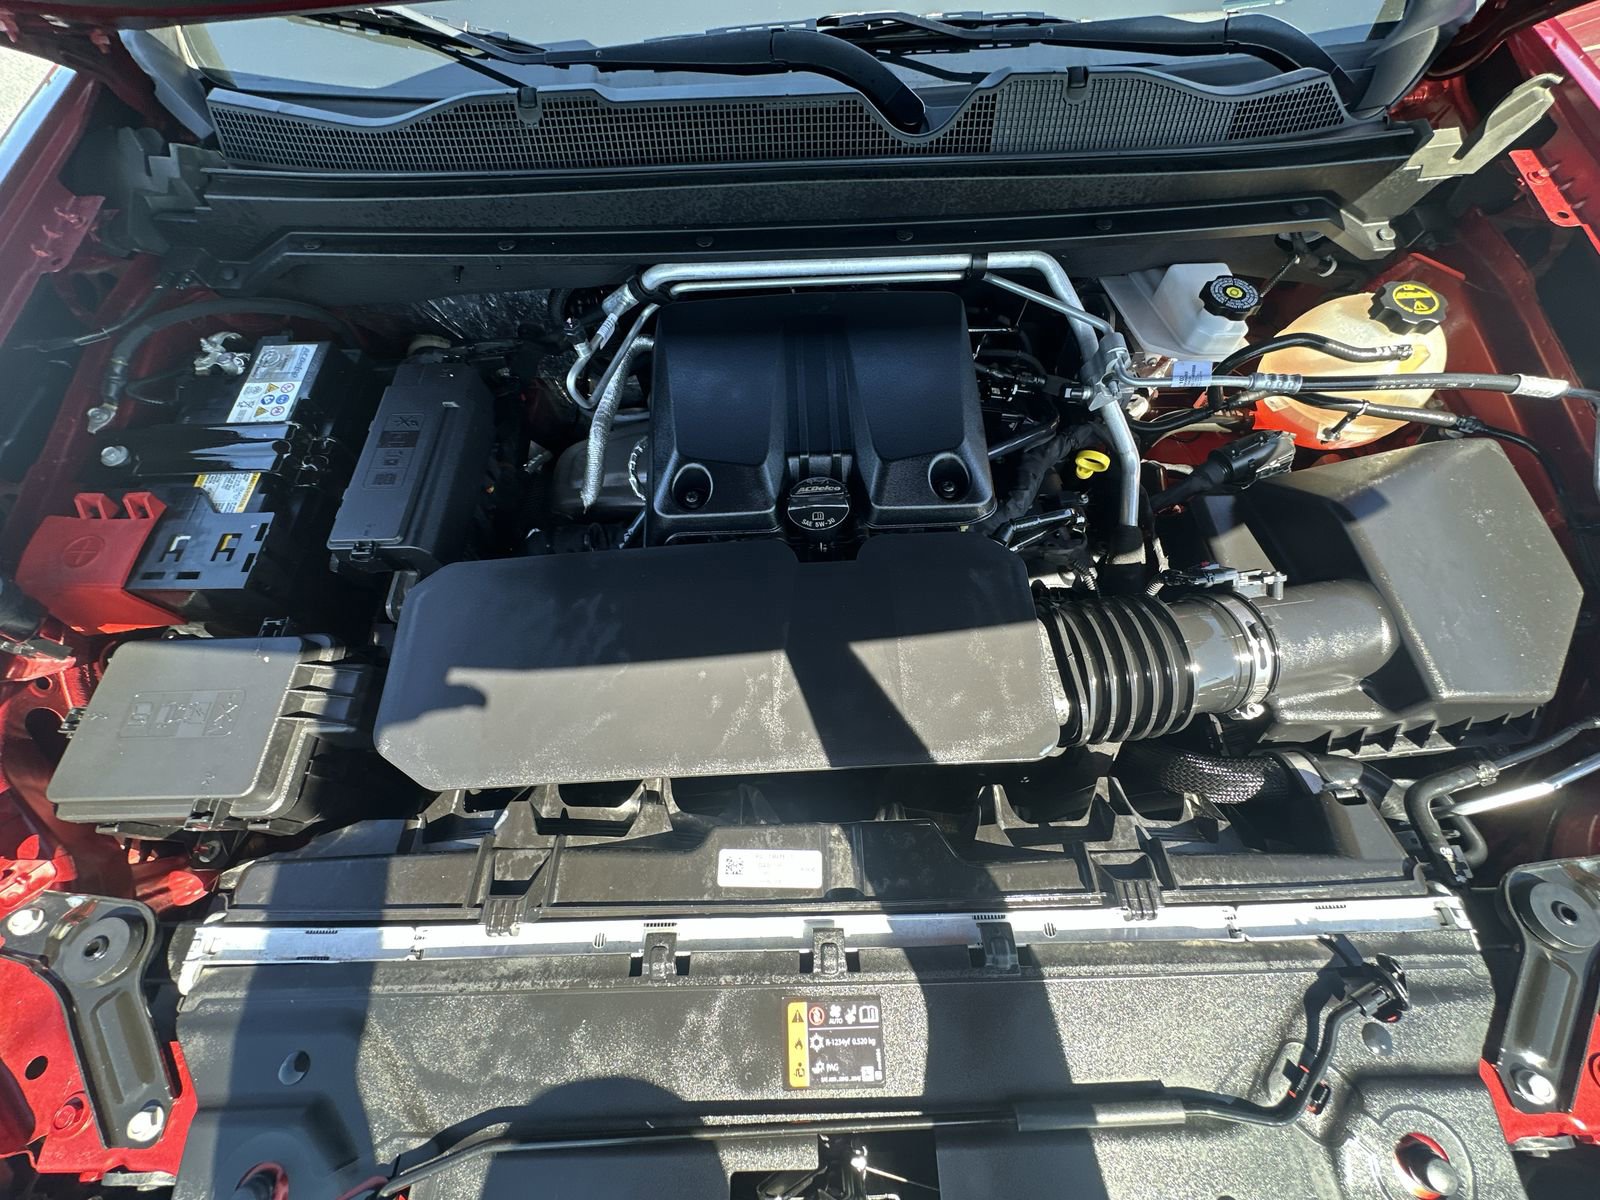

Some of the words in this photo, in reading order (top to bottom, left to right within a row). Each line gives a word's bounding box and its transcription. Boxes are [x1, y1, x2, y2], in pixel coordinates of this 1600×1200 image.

[797, 485, 841, 493] ACDelco
[802, 519, 813, 527] SAE
[815, 518, 835, 527] 5W-30
[852, 1037, 867, 1045] 0.520
